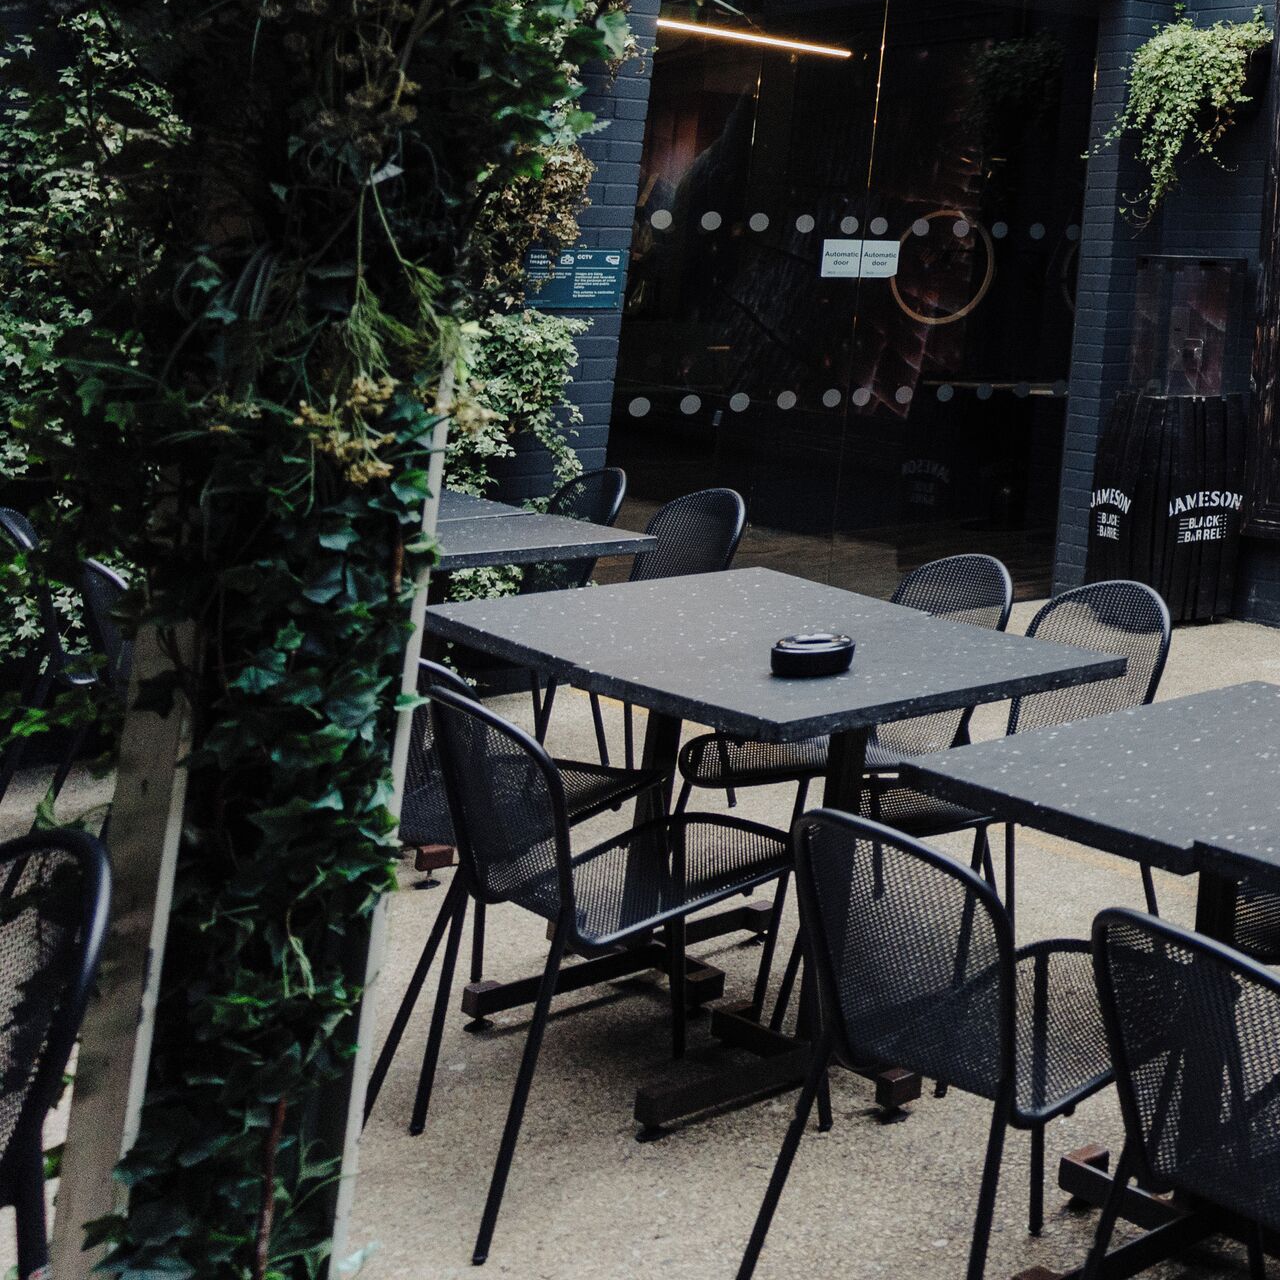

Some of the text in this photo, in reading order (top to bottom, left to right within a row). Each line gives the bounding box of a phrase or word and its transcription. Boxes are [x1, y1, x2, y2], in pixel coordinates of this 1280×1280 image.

[1090, 488, 1132, 515] JAMESON
[1188, 515, 1219, 530] BLACK
[1184, 528, 1222, 543] BARREL
